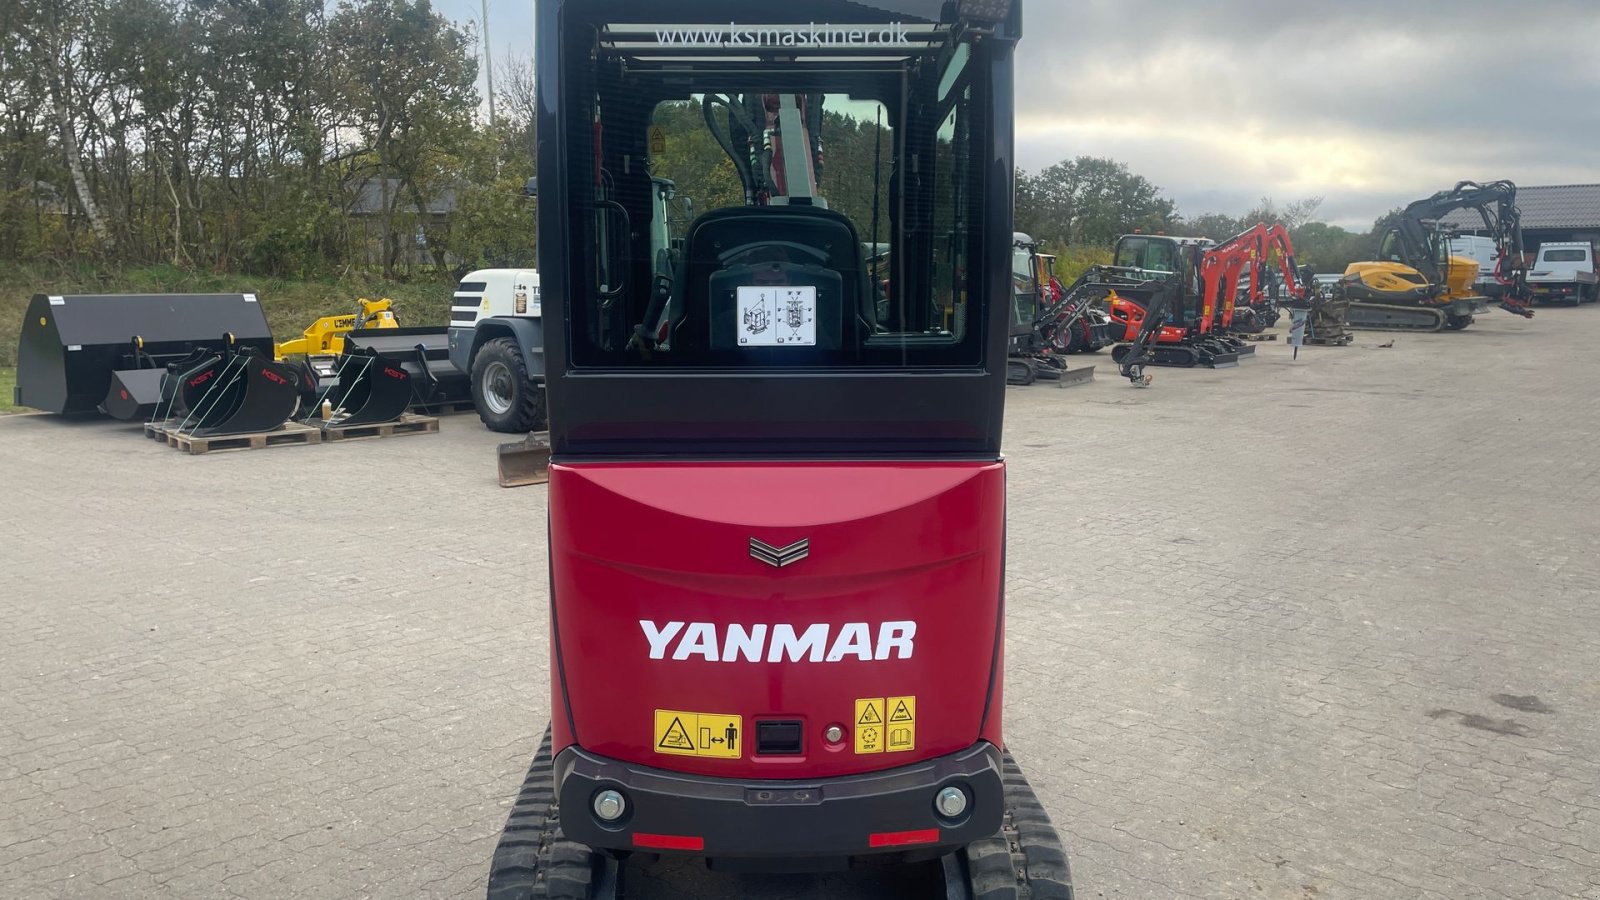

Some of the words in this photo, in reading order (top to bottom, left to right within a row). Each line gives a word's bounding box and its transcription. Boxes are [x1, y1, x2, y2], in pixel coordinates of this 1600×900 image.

[655, 21, 910, 47] www.ksmaskiner.dk
[261, 368, 287, 385] KST
[639, 620, 917, 663] YANMAR
